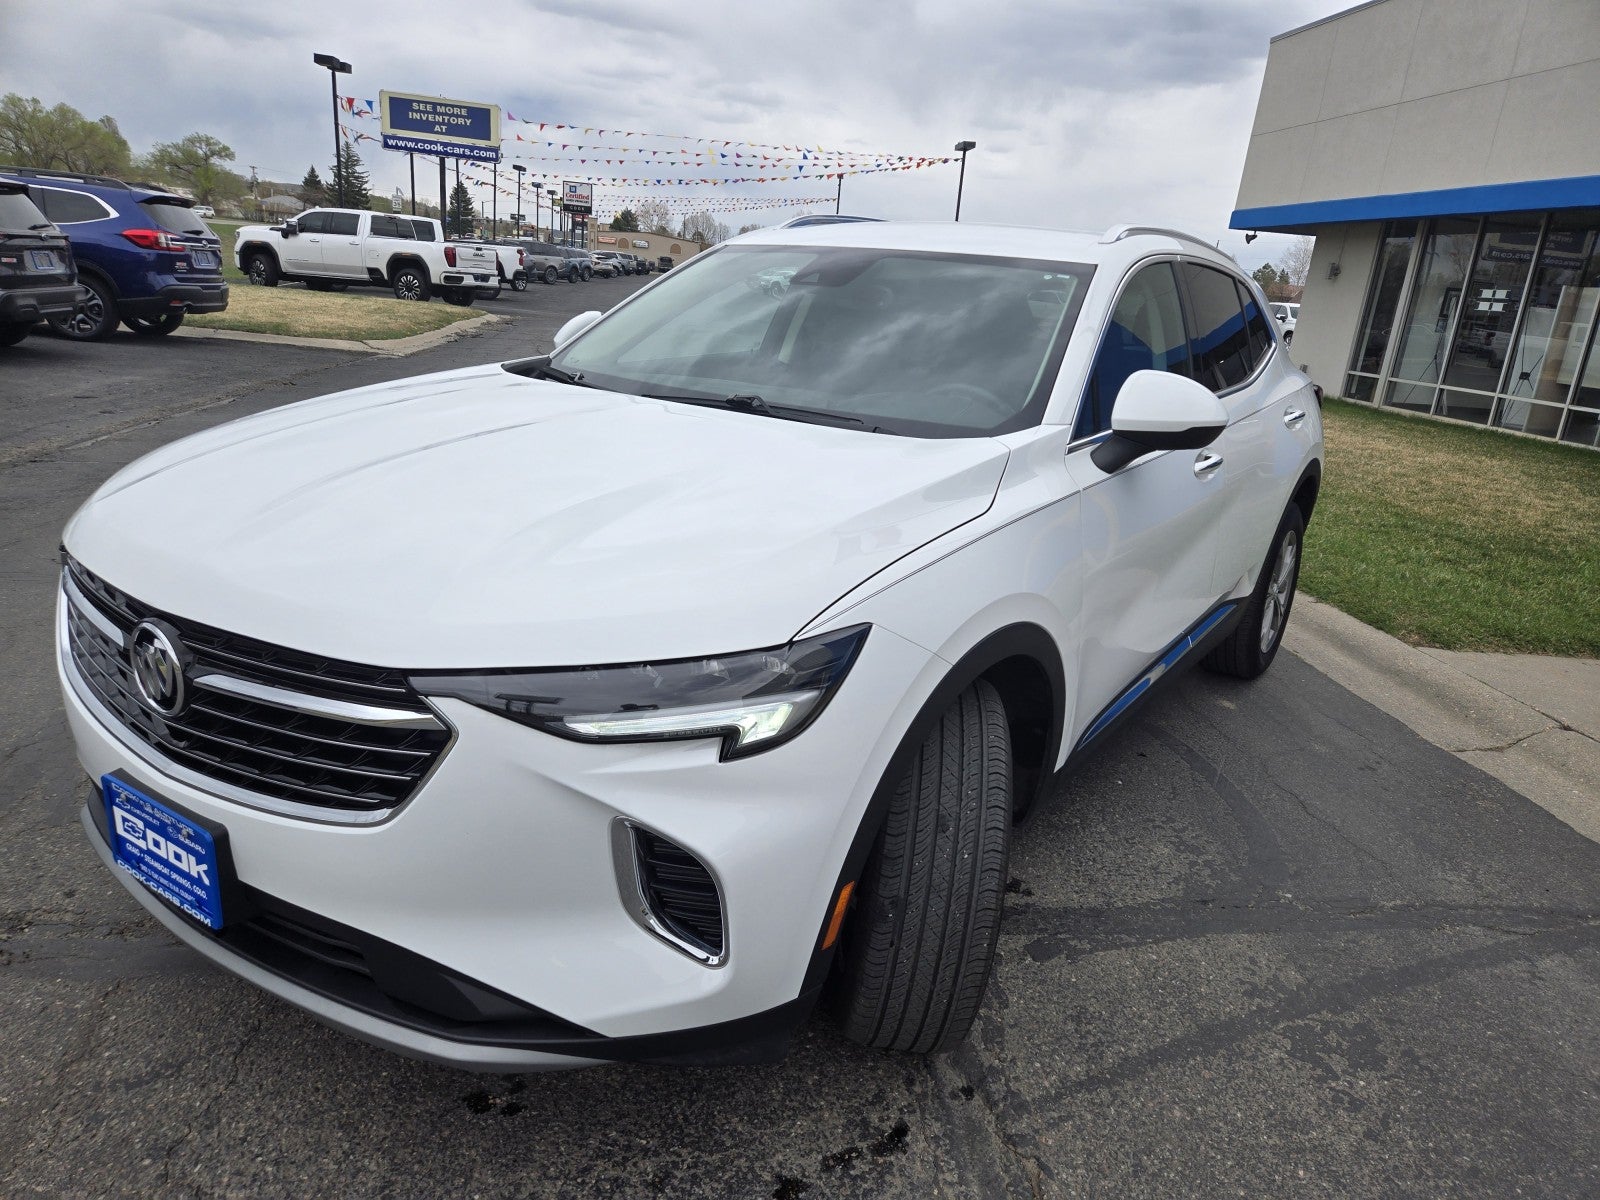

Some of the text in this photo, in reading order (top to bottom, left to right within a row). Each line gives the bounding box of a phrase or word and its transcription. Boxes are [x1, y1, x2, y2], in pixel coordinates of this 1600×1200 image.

[412, 102, 468, 116] SEE MORE
[408, 111, 472, 126] INVENTORY
[434, 125, 447, 133] AT
[387, 138, 496, 159] www.cook-cars.com
[116, 859, 212, 927] COOK-CARS.COM
